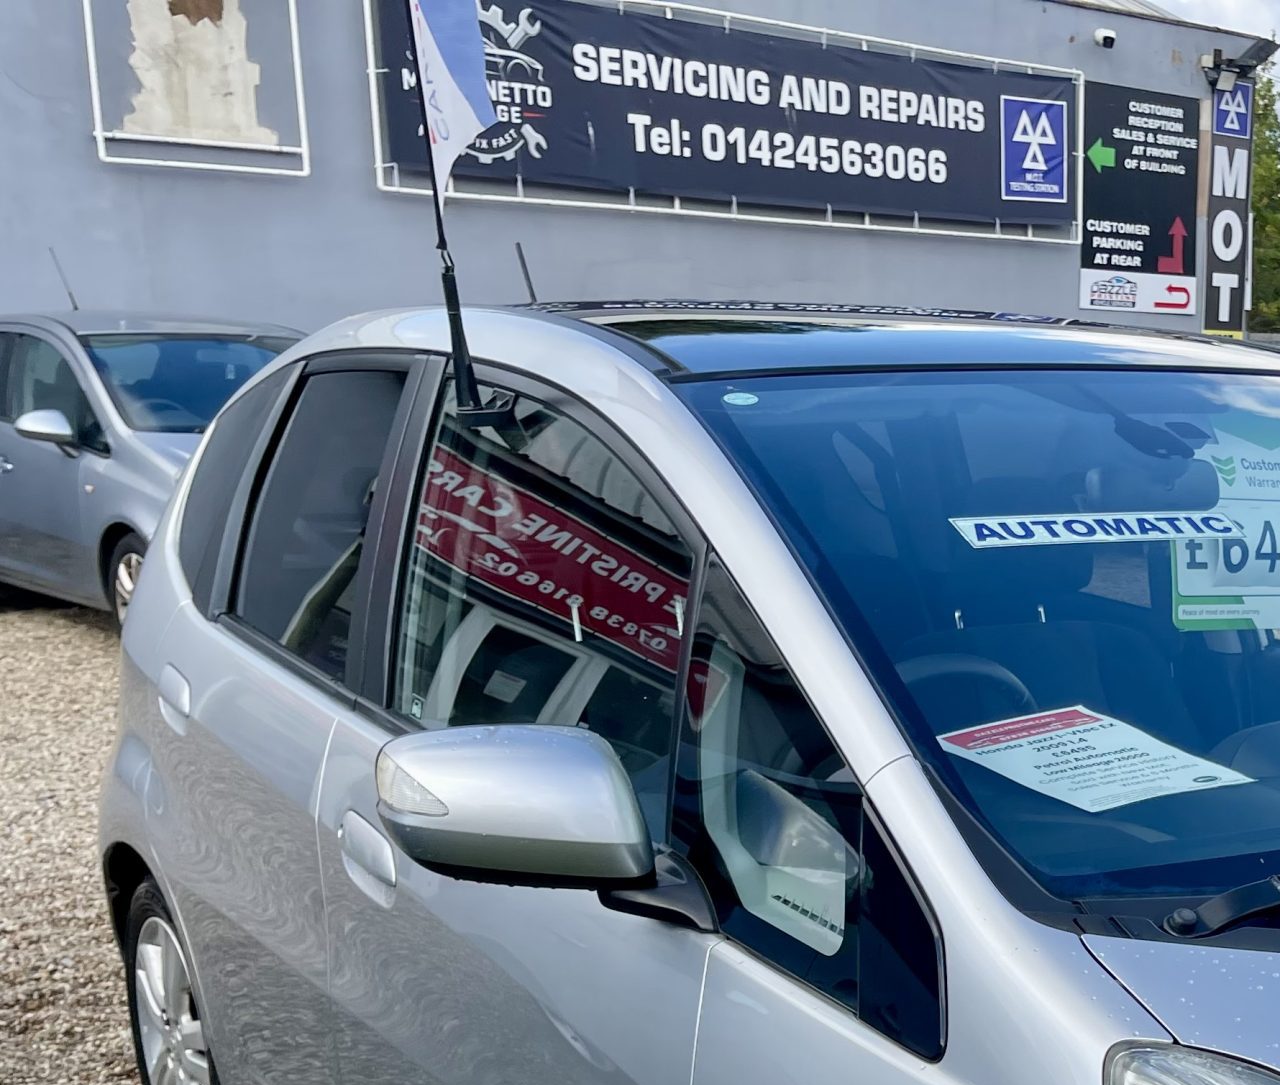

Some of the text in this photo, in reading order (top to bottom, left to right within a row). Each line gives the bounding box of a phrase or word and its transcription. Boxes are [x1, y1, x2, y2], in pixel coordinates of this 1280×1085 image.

[572, 43, 987, 133] SERVICING AND REPAIRS
[1128, 101, 1184, 119] CUSTOMER
[1127, 115, 1184, 133] RECEPTION
[491, 128, 518, 149] FAST
[1112, 127, 1198, 149] SALES & SERVICE
[627, 113, 949, 185] Tel: 01424563066
[1131, 145, 1179, 160] AT FRONT
[1123, 158, 1186, 175] OF BUILDING
[1086, 219, 1150, 236] CUSTOMER
[1211, 145, 1249, 322] MOT
[1092, 235, 1144, 252] PARKING
[1093, 252, 1142, 267] AT REAR
[974, 516, 1233, 543] AUTOMATIC
[975, 742, 1024, 756] Honda
[1026, 735, 1057, 747] Jazz
[1032, 737, 1089, 753] 2009 1.4
[1051, 745, 1097, 758] £6495
[1033, 746, 1140, 770] Petrol Automatic
[1043, 766, 1068, 776] Low
[1067, 758, 1115, 773] Mileage
